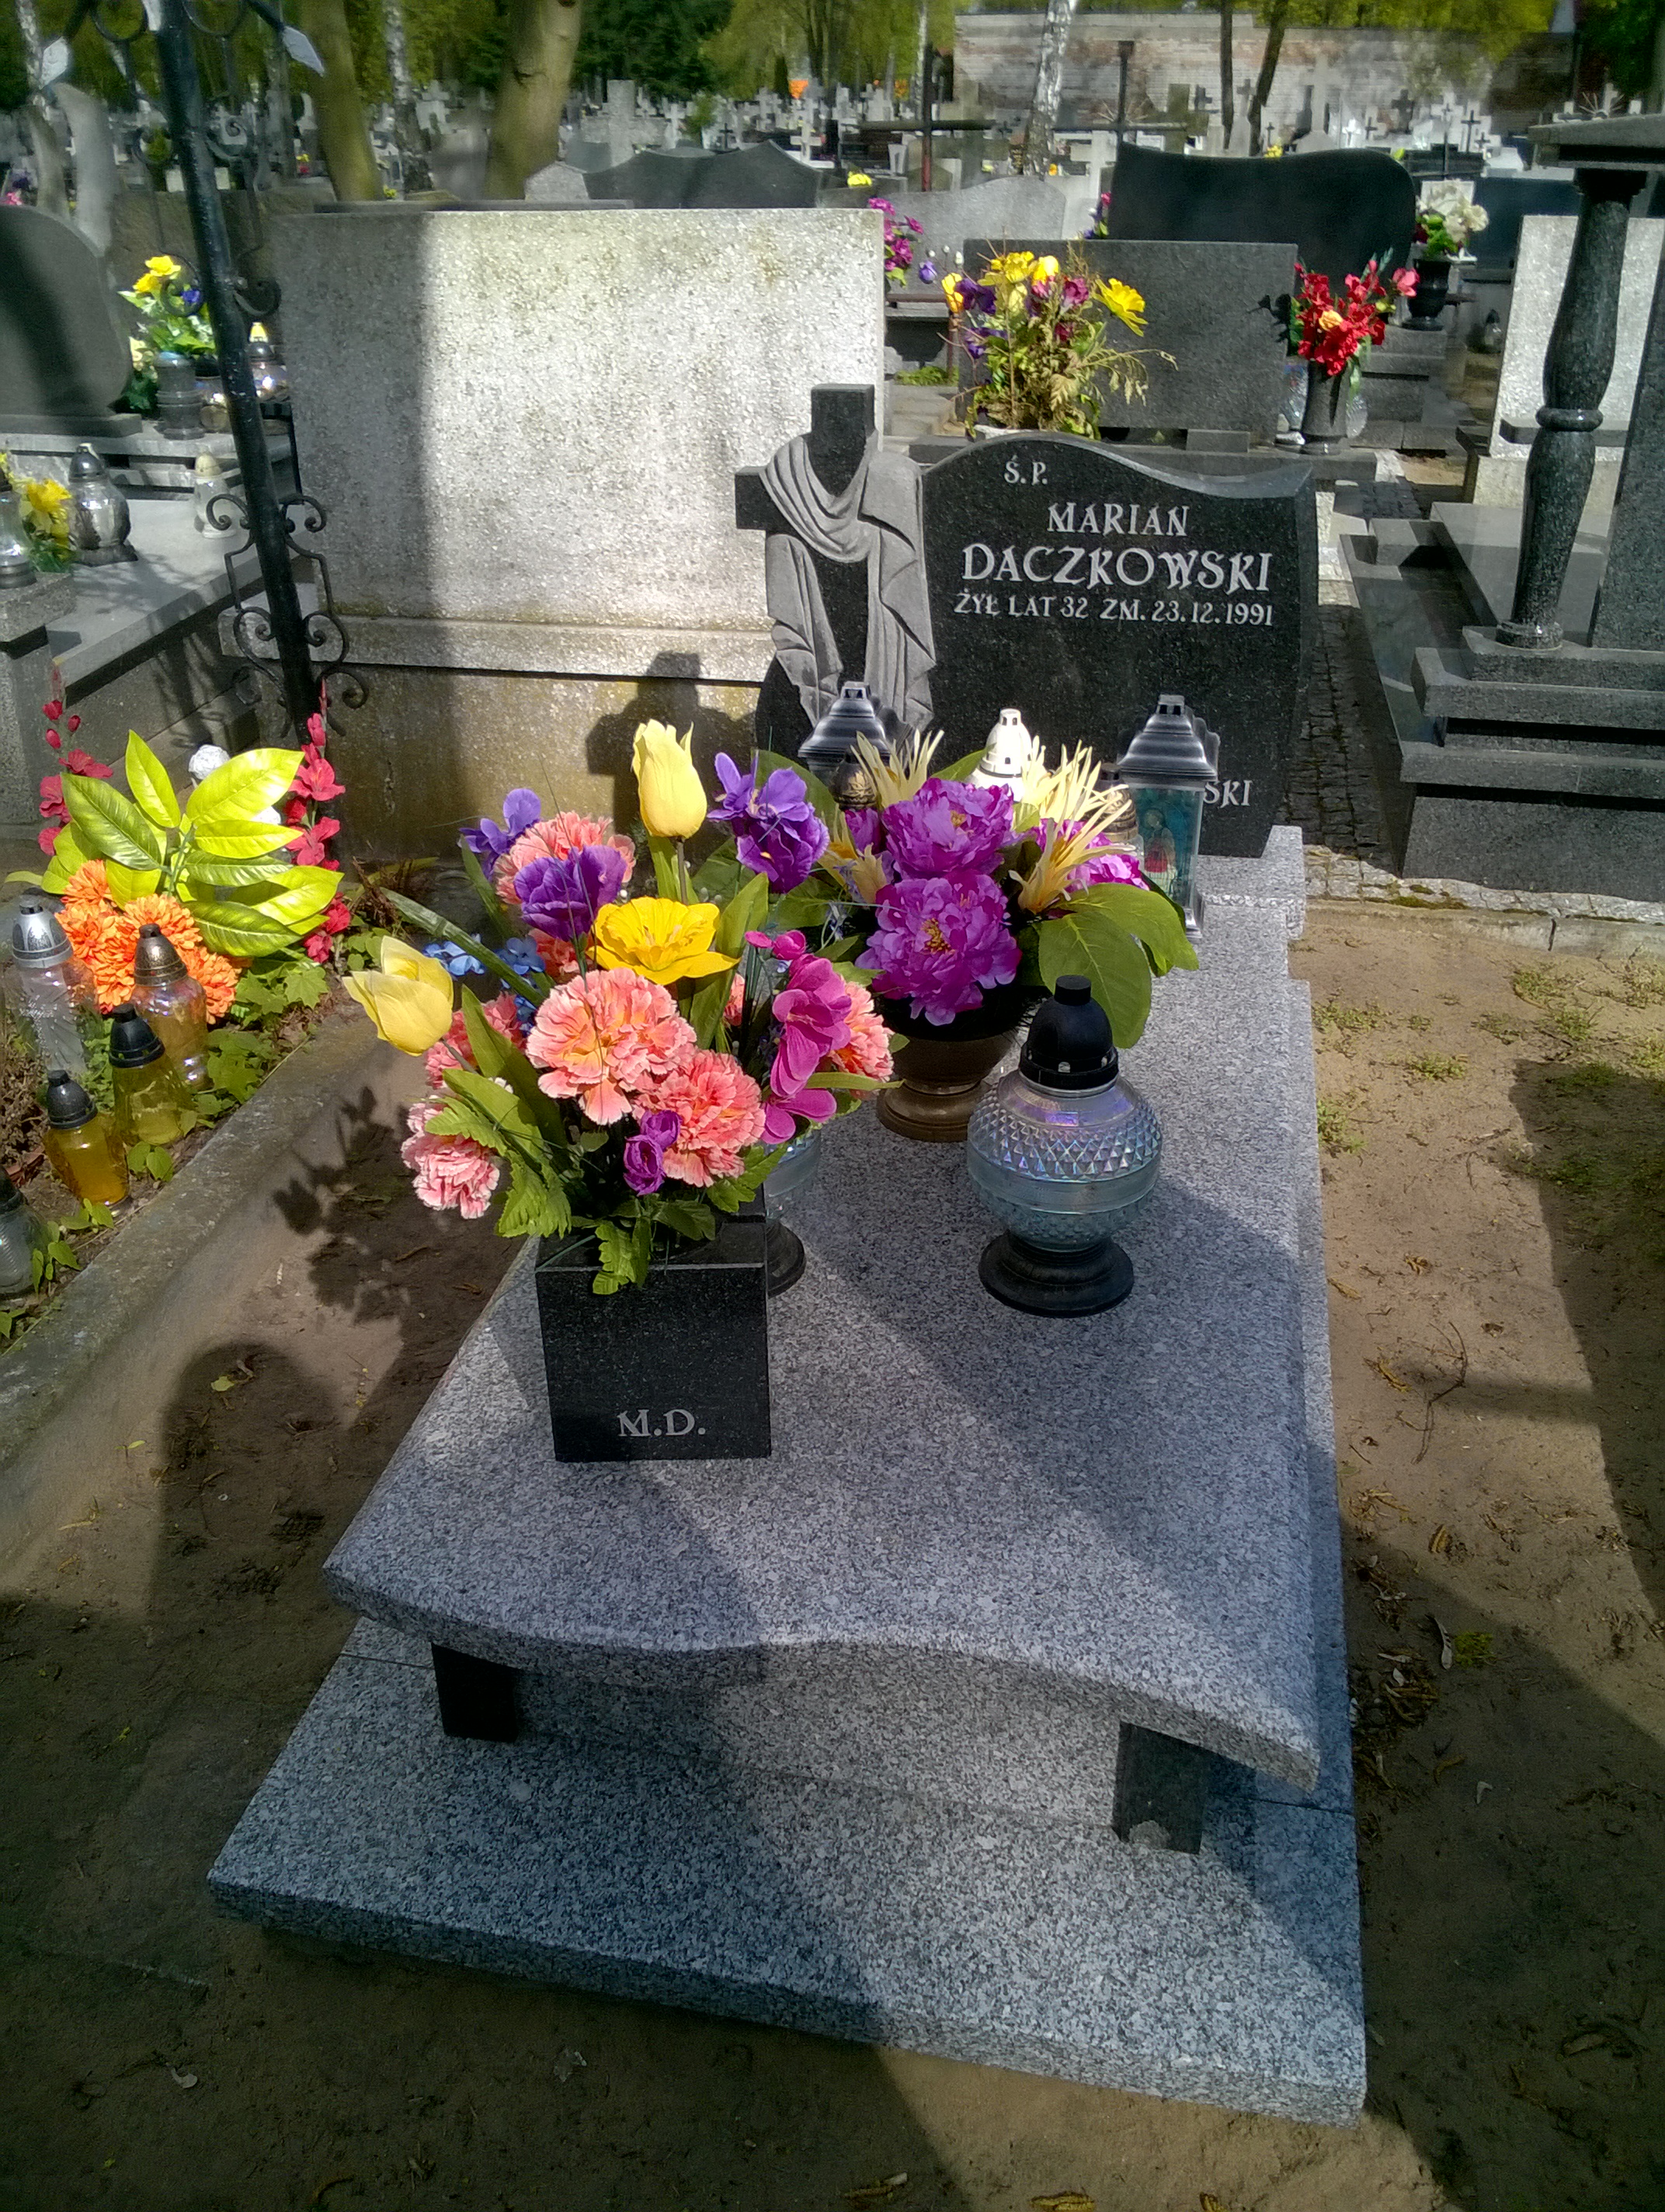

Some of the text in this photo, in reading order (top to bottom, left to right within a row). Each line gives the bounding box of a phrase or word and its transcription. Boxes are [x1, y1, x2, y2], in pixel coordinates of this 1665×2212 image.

[1047, 502, 1190, 537] MARIAN
[961, 542, 1272, 595] DACZKOWSKI
[954, 587, 1000, 616] ŻYŁ
[1008, 593, 1057, 617] LAT
[1060, 595, 1089, 618] 32
[1099, 598, 1146, 621] ZM.
[617, 1409, 706, 1437] M.D.
